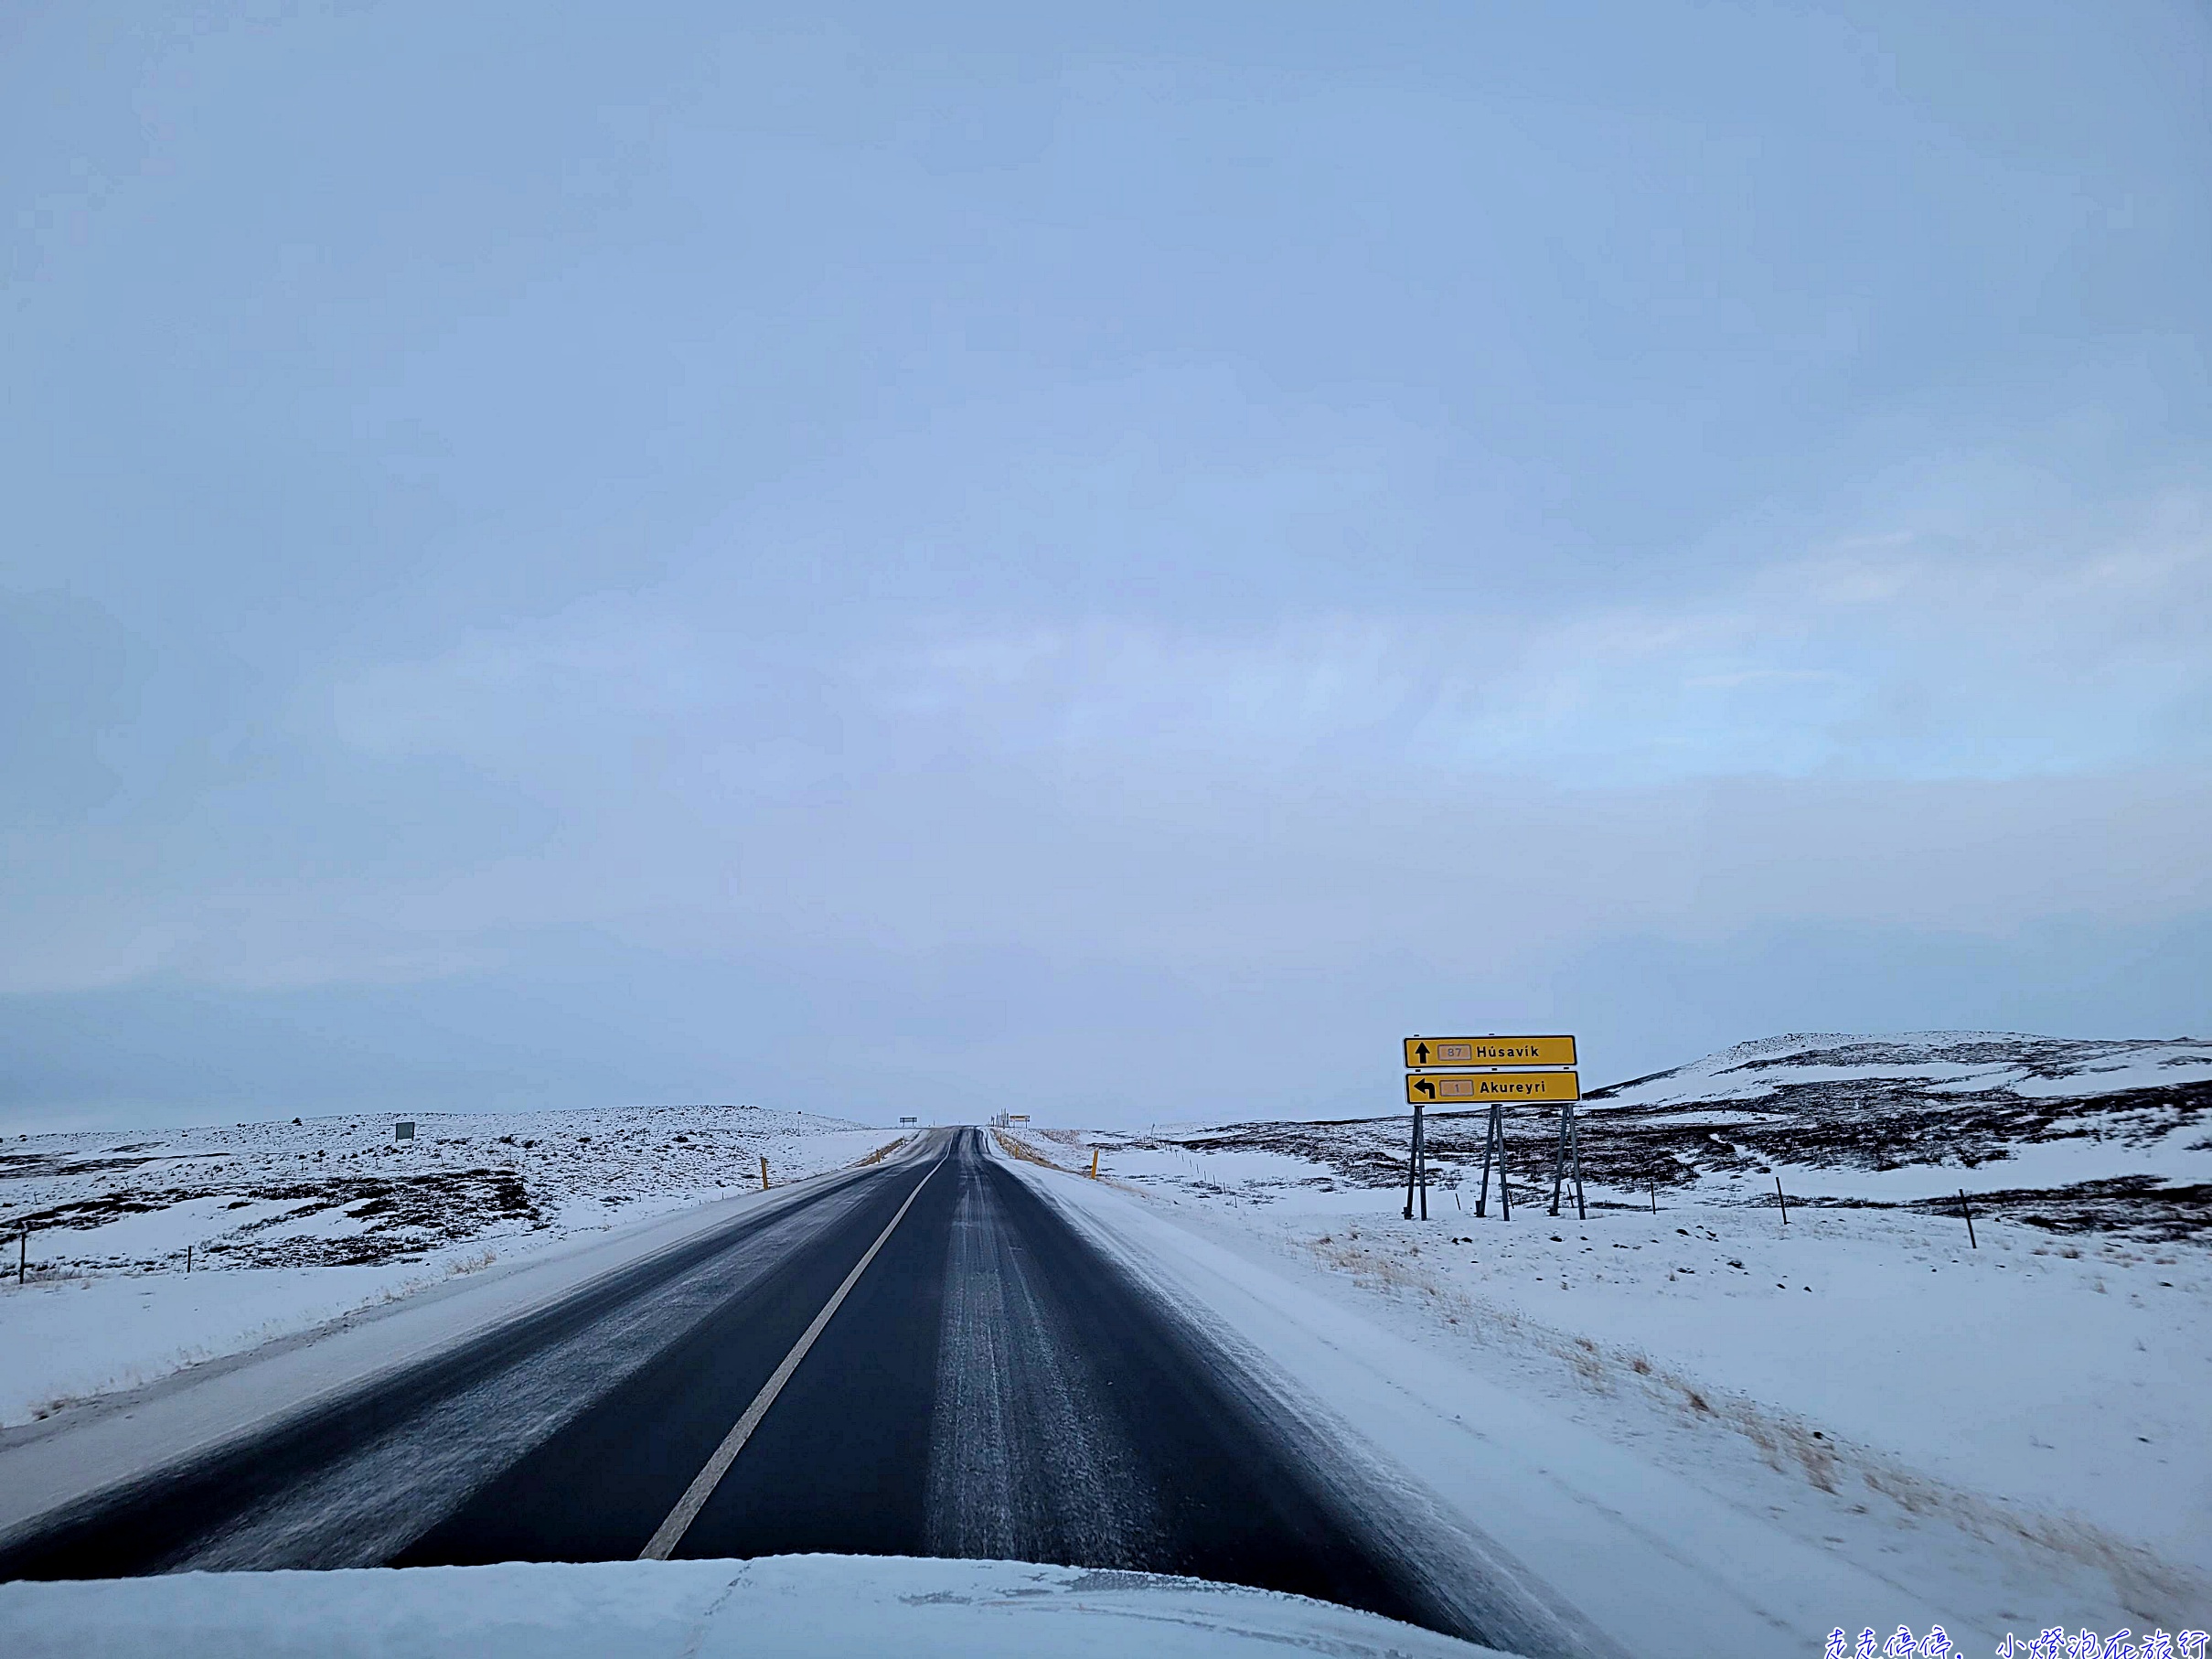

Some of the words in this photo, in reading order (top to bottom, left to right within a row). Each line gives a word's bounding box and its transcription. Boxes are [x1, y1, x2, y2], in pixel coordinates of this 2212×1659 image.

[1448, 1048, 1462, 1057] 87
[1477, 1045, 1539, 1057] Húsavík
[1480, 1081, 1545, 1096] Akureyri
